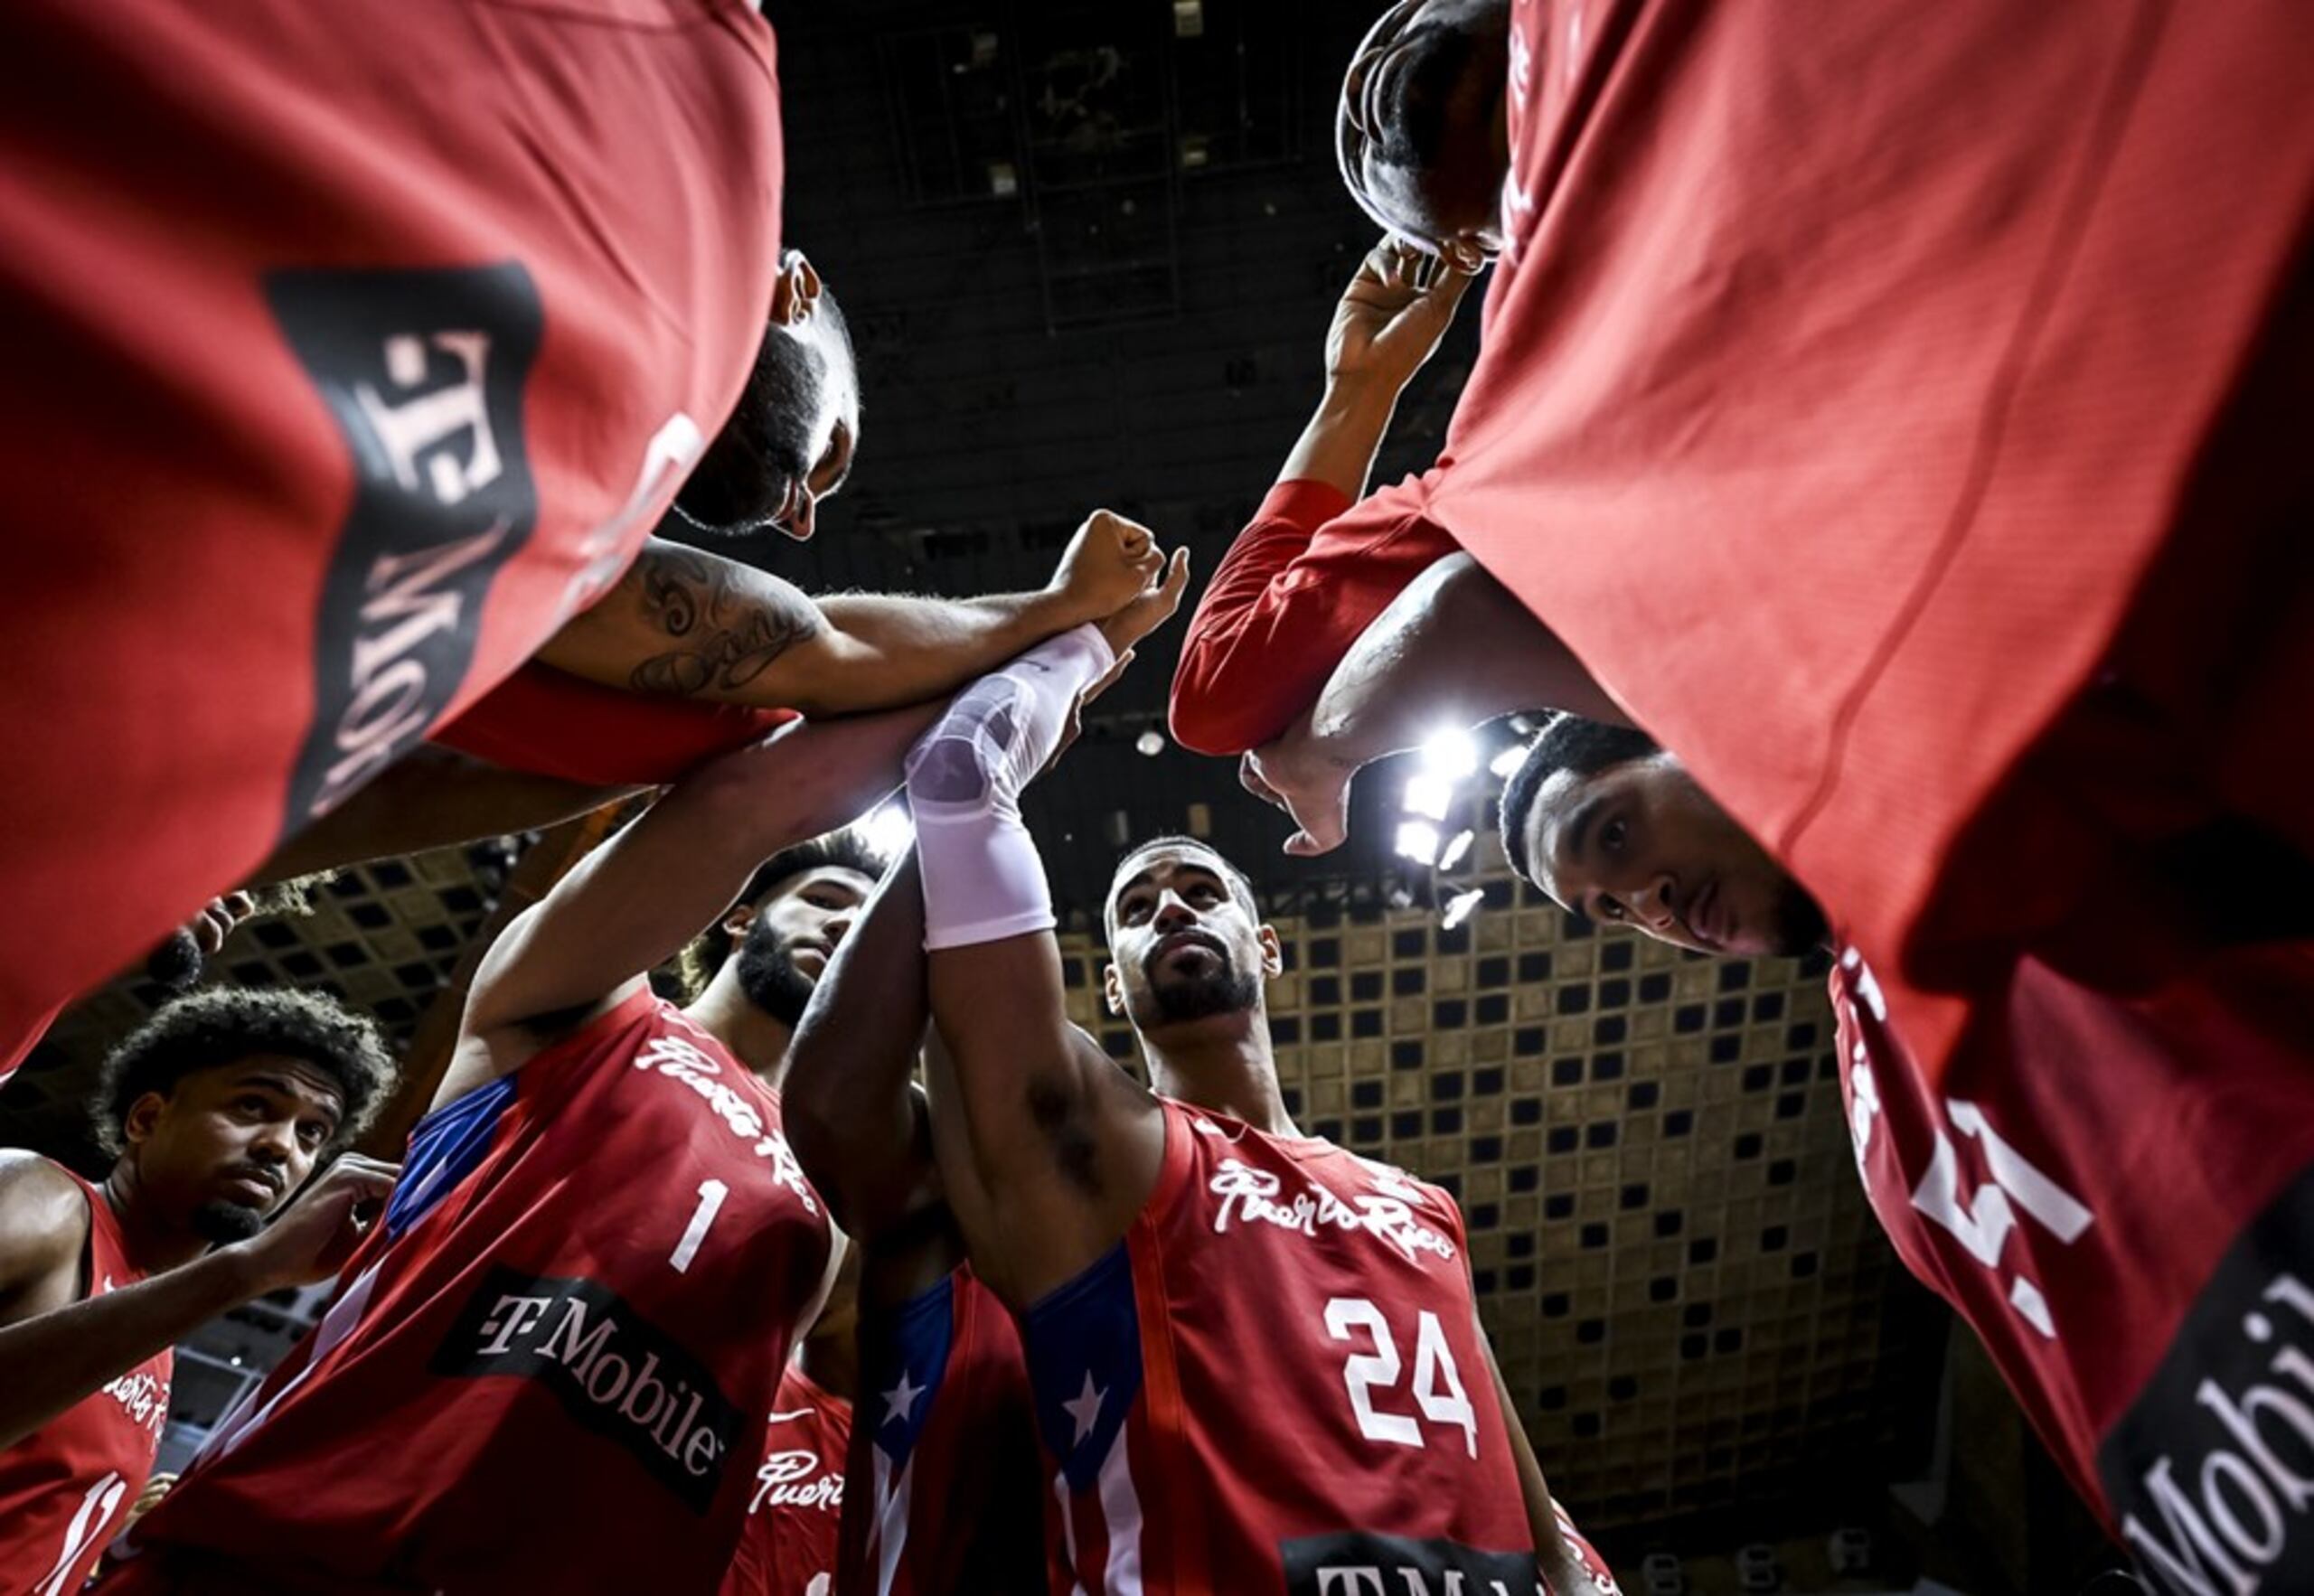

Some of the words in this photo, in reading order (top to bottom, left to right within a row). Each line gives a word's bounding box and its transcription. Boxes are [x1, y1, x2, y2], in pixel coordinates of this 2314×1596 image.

[635, 1035, 762, 1137] Puerto
[755, 1128, 819, 1217] Rico
[670, 1178, 729, 1274] 1
[1210, 1159, 1357, 1236] Puerto
[1353, 1195, 1454, 1263] Rico
[1324, 1297, 1477, 1460] 24
